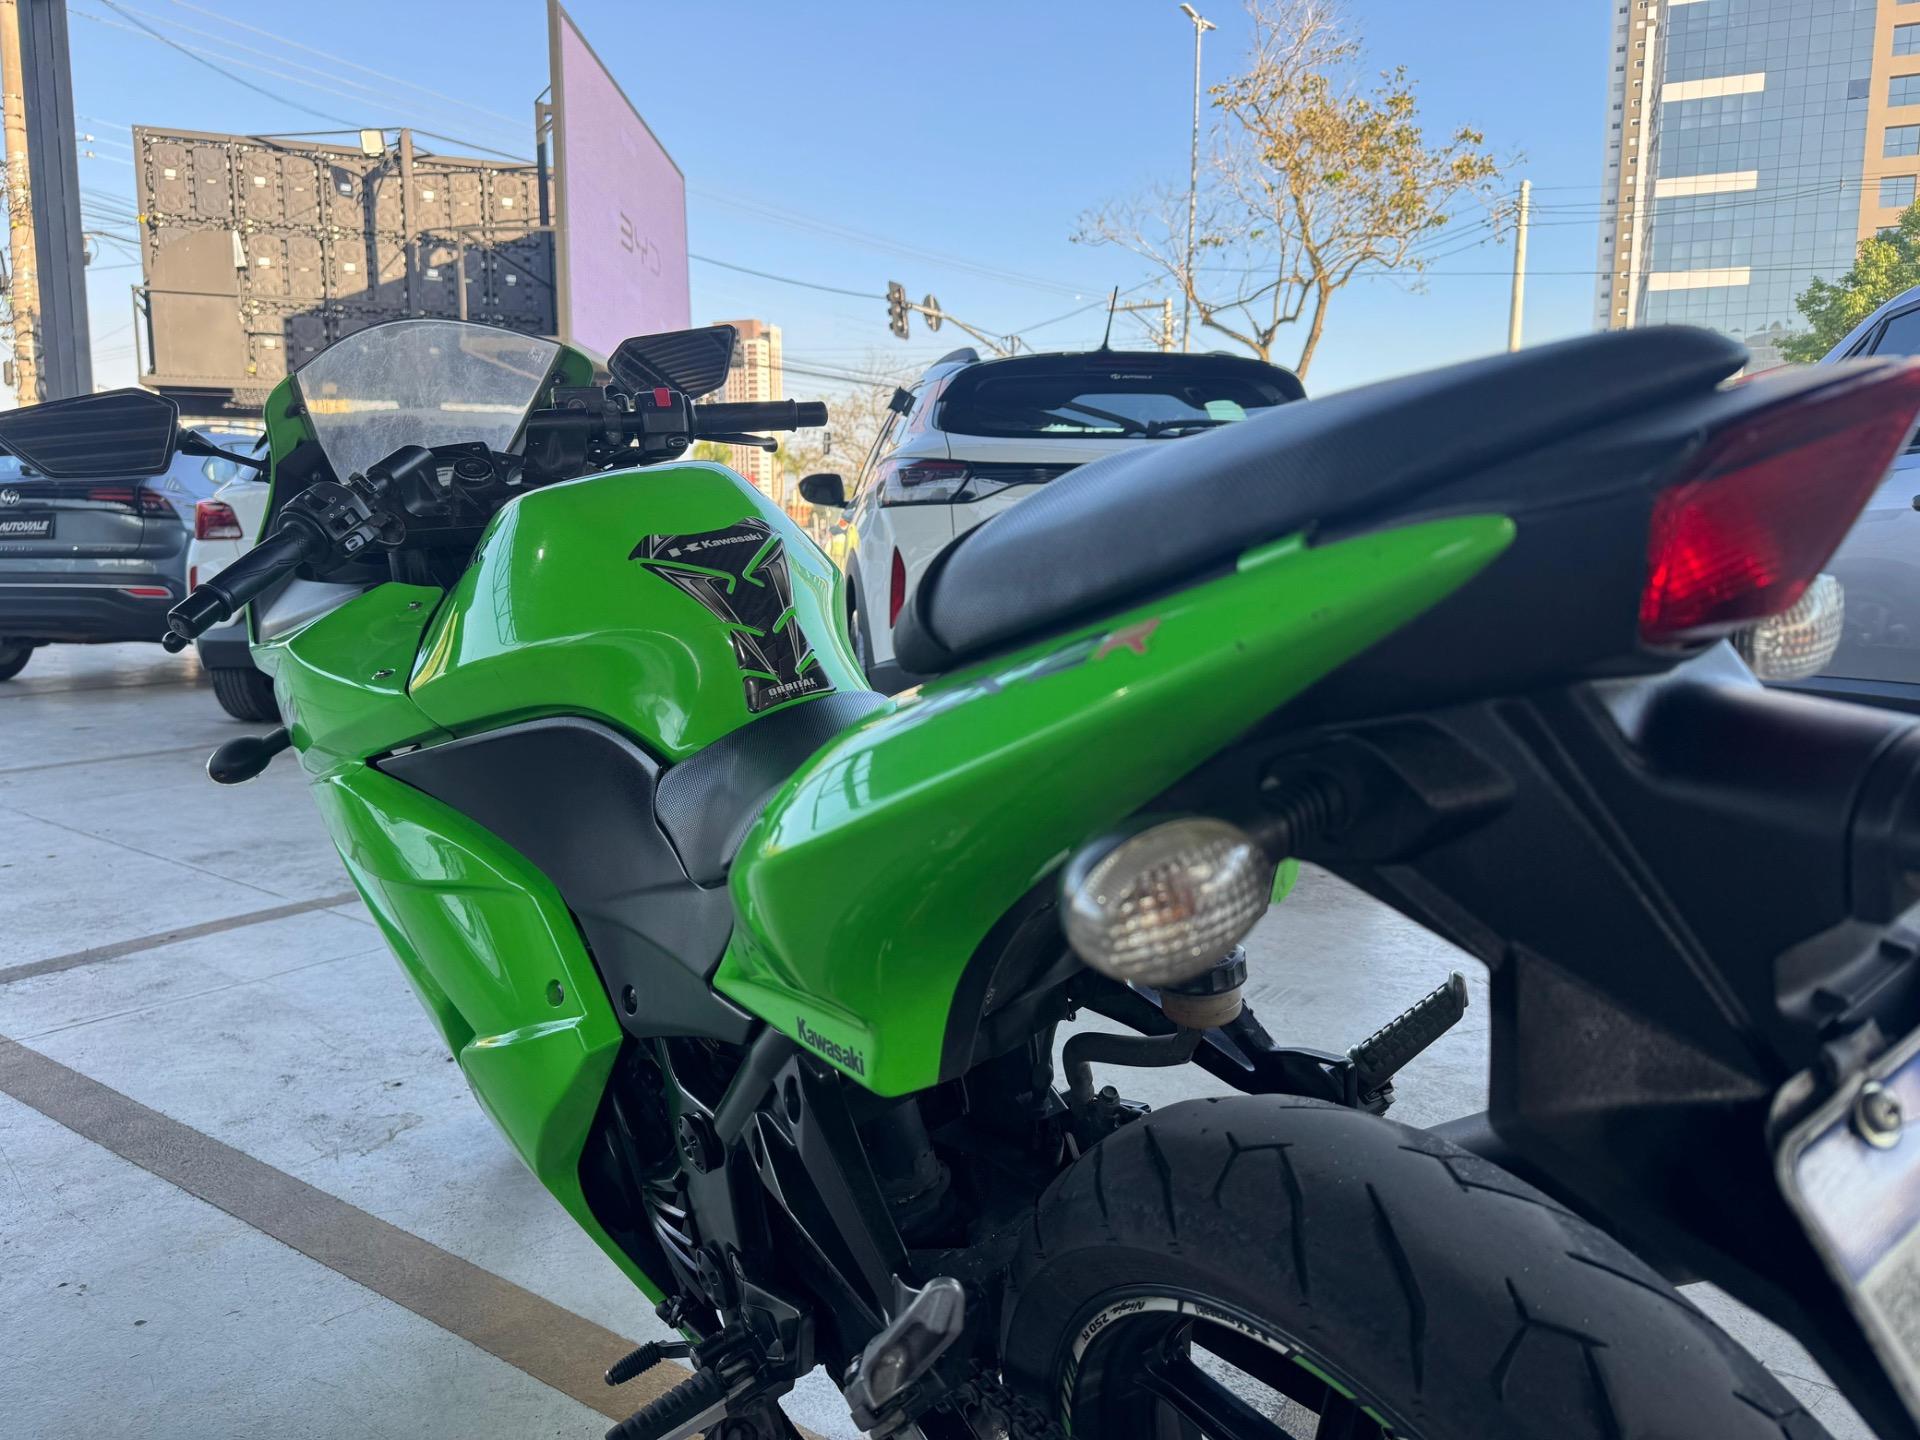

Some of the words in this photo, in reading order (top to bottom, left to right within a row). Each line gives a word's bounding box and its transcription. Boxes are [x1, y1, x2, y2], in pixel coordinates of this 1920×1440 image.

[0, 520, 50, 532] AUTOVALE
[702, 533, 763, 549] Kawasaki
[768, 678, 816, 695] ORBITAL
[796, 1016, 864, 1077] Kawasaki
